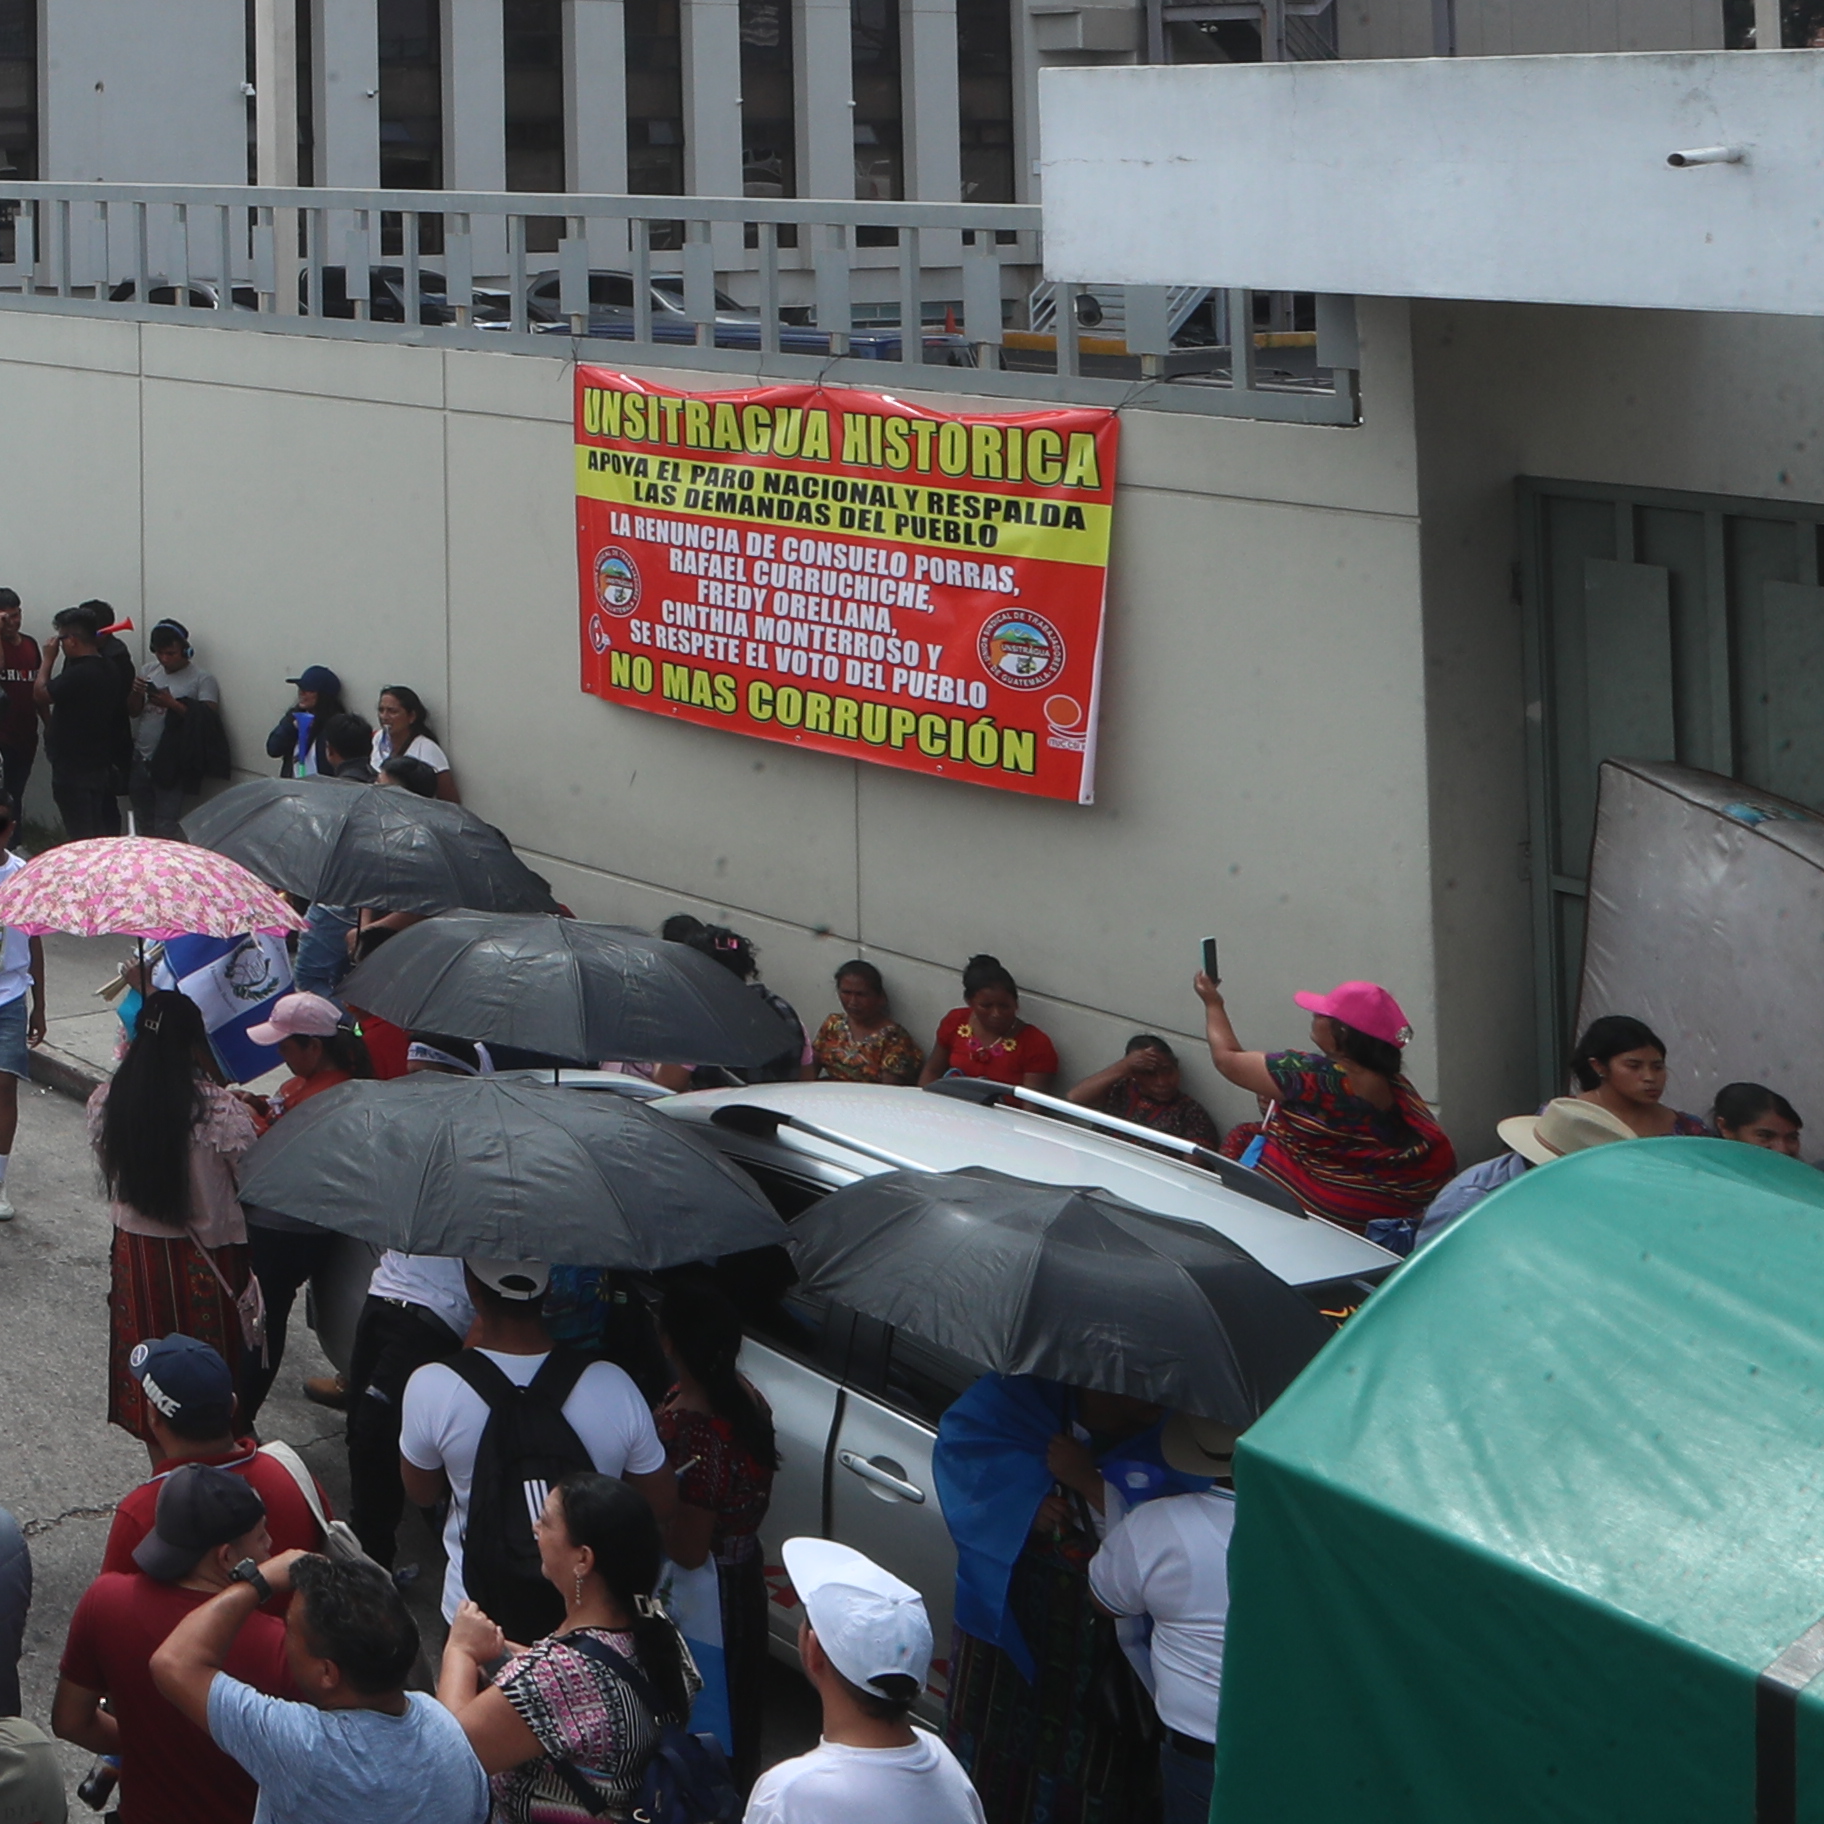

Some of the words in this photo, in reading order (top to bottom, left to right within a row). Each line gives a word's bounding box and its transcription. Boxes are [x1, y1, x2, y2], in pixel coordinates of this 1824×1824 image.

[582, 386, 831, 462] UNSITRAGUA
[842, 413, 1102, 491] HISTORICA
[587, 449, 651, 480] APOYA
[657, 460, 684, 484] EL
[690, 465, 754, 493] PARO
[762, 472, 904, 510] NACIONAL
[904, 489, 921, 512] Y
[927, 491, 1087, 531] RESPALDA
[633, 480, 680, 507] LAS
[684, 485, 832, 528] DEMANDAS
[839, 506, 887, 534] DEL
[894, 510, 1000, 550] PUEBLO
[609, 510, 631, 538] LA
[634, 512, 741, 554] RENUNCIA
[745, 527, 776, 558] DE
[782, 533, 907, 577] CONSUELO
[913, 552, 1021, 597] PORRAS,
[668, 548, 748, 584] RAFAEL
[752, 561, 936, 615] CURRUCHICHE,
[660, 598, 749, 639] CINTHIA
[753, 614, 921, 666] MONTERROSO
[925, 642, 943, 672] Y
[697, 576, 767, 612] FREDY
[771, 589, 898, 637] ORELLANA,
[629, 619, 652, 646] SE
[654, 623, 741, 666] RESPETE
[745, 640, 771, 669] EL
[774, 645, 840, 682] VOTO
[845, 658, 889, 692] DEL
[893, 667, 988, 711] PUEBLO
[1001, 644, 1051, 657] UNSITRAGUA
[609, 649, 654, 695] NO
[661, 661, 739, 716] MAS
[747, 679, 1038, 777] CORRUPCIÓN
[141, 1372, 181, 1418] NIKE
